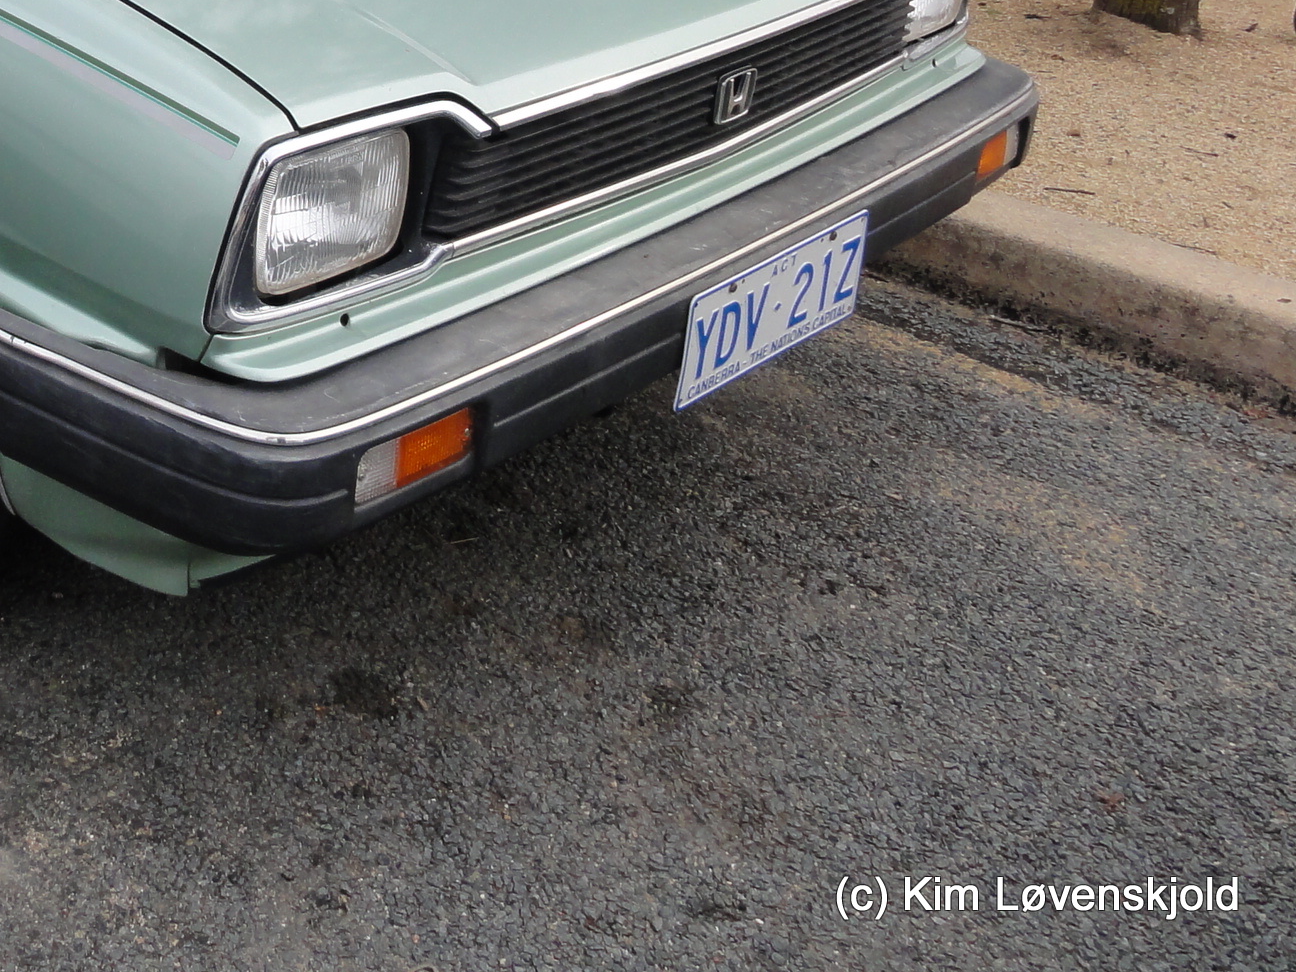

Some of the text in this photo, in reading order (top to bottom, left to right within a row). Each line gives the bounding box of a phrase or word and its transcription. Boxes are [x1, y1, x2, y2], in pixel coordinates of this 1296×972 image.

[771, 253, 798, 278] ACT
[687, 363, 741, 400] CANBERRA
[749, 344, 768, 365] THE
[812, 304, 847, 330] CAPITAL
